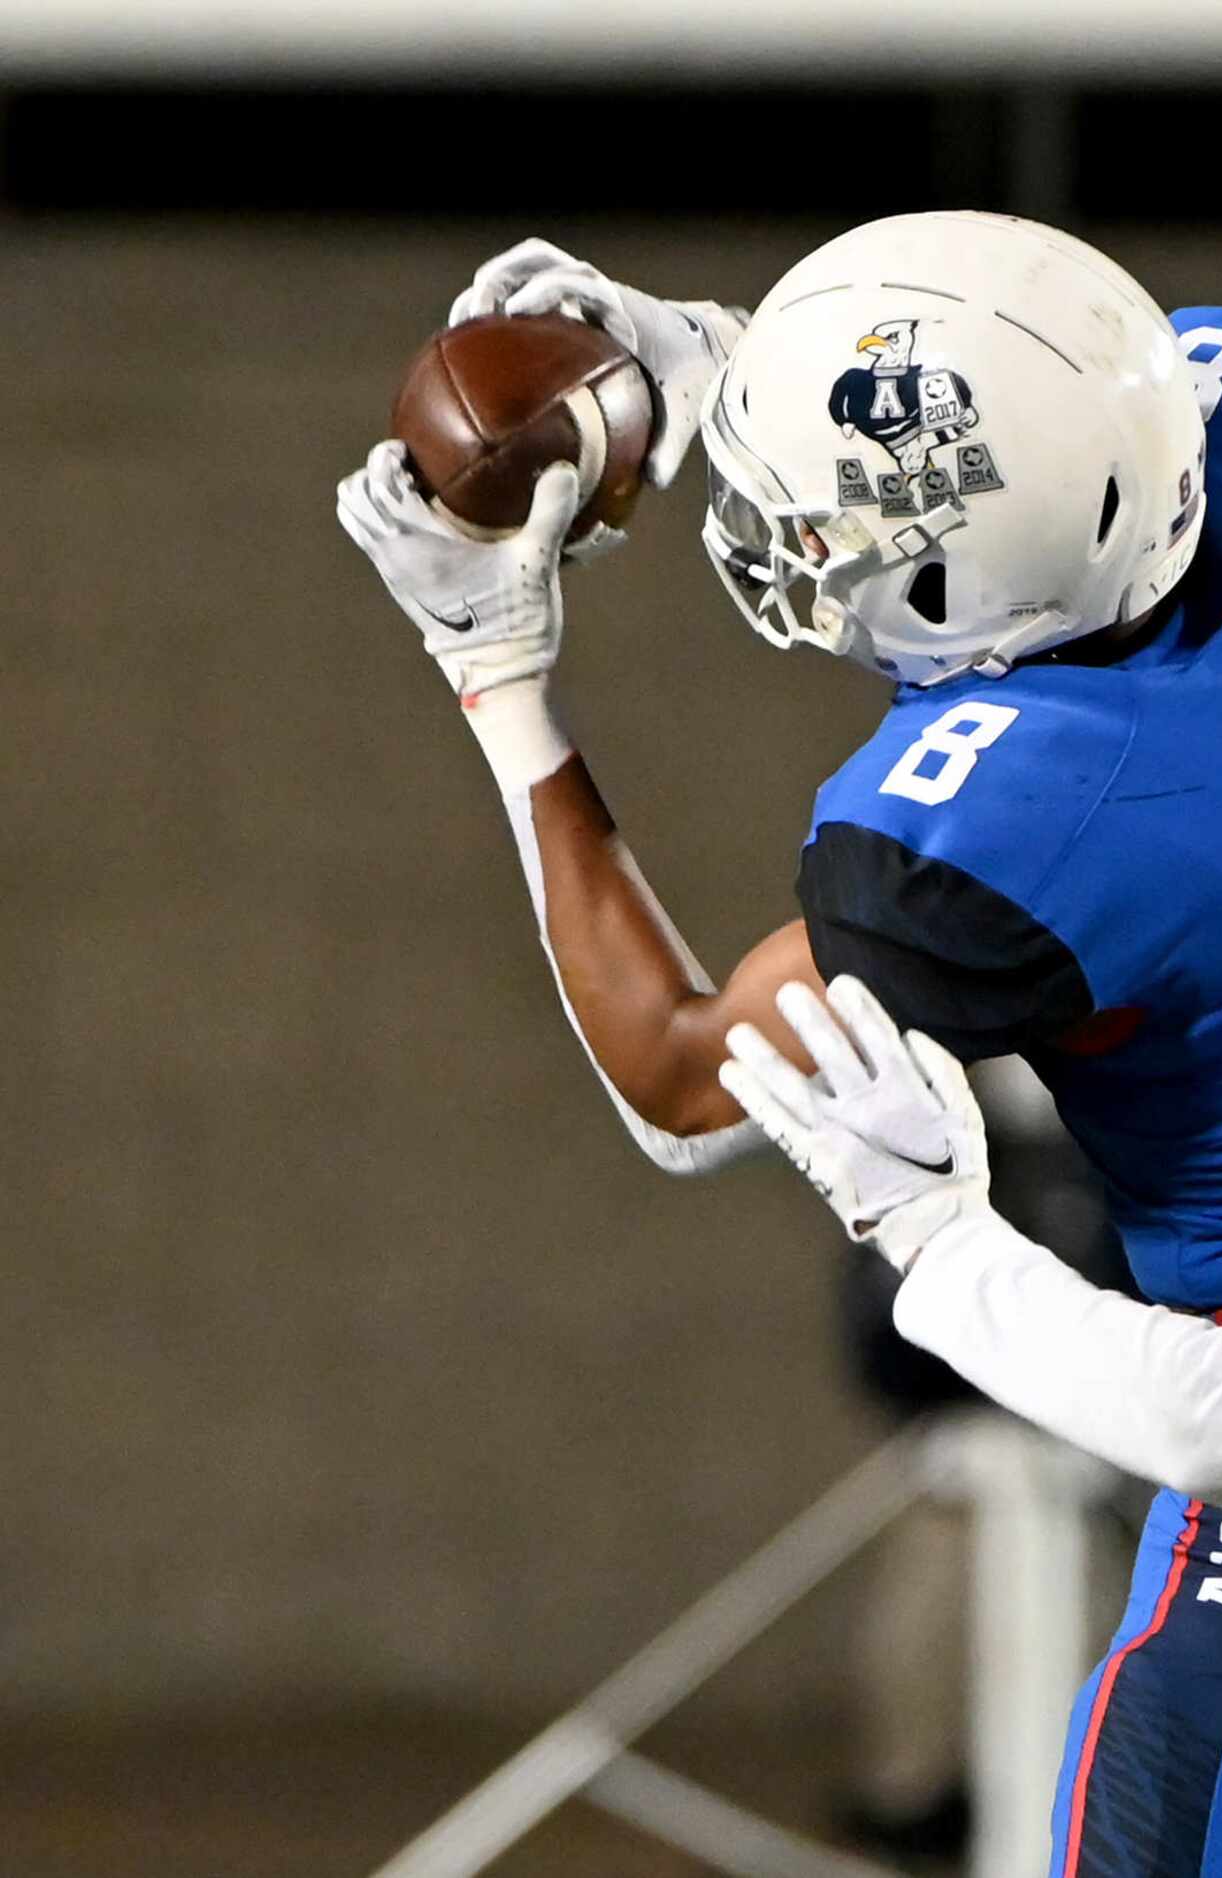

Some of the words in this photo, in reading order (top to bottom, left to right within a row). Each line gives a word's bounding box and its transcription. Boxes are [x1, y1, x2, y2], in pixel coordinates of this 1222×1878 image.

[869, 378, 906, 420] A
[924, 401, 958, 423] 2017
[962, 468, 994, 486] 2014
[1179, 468, 1192, 506] 8
[879, 701, 1021, 806] 8
